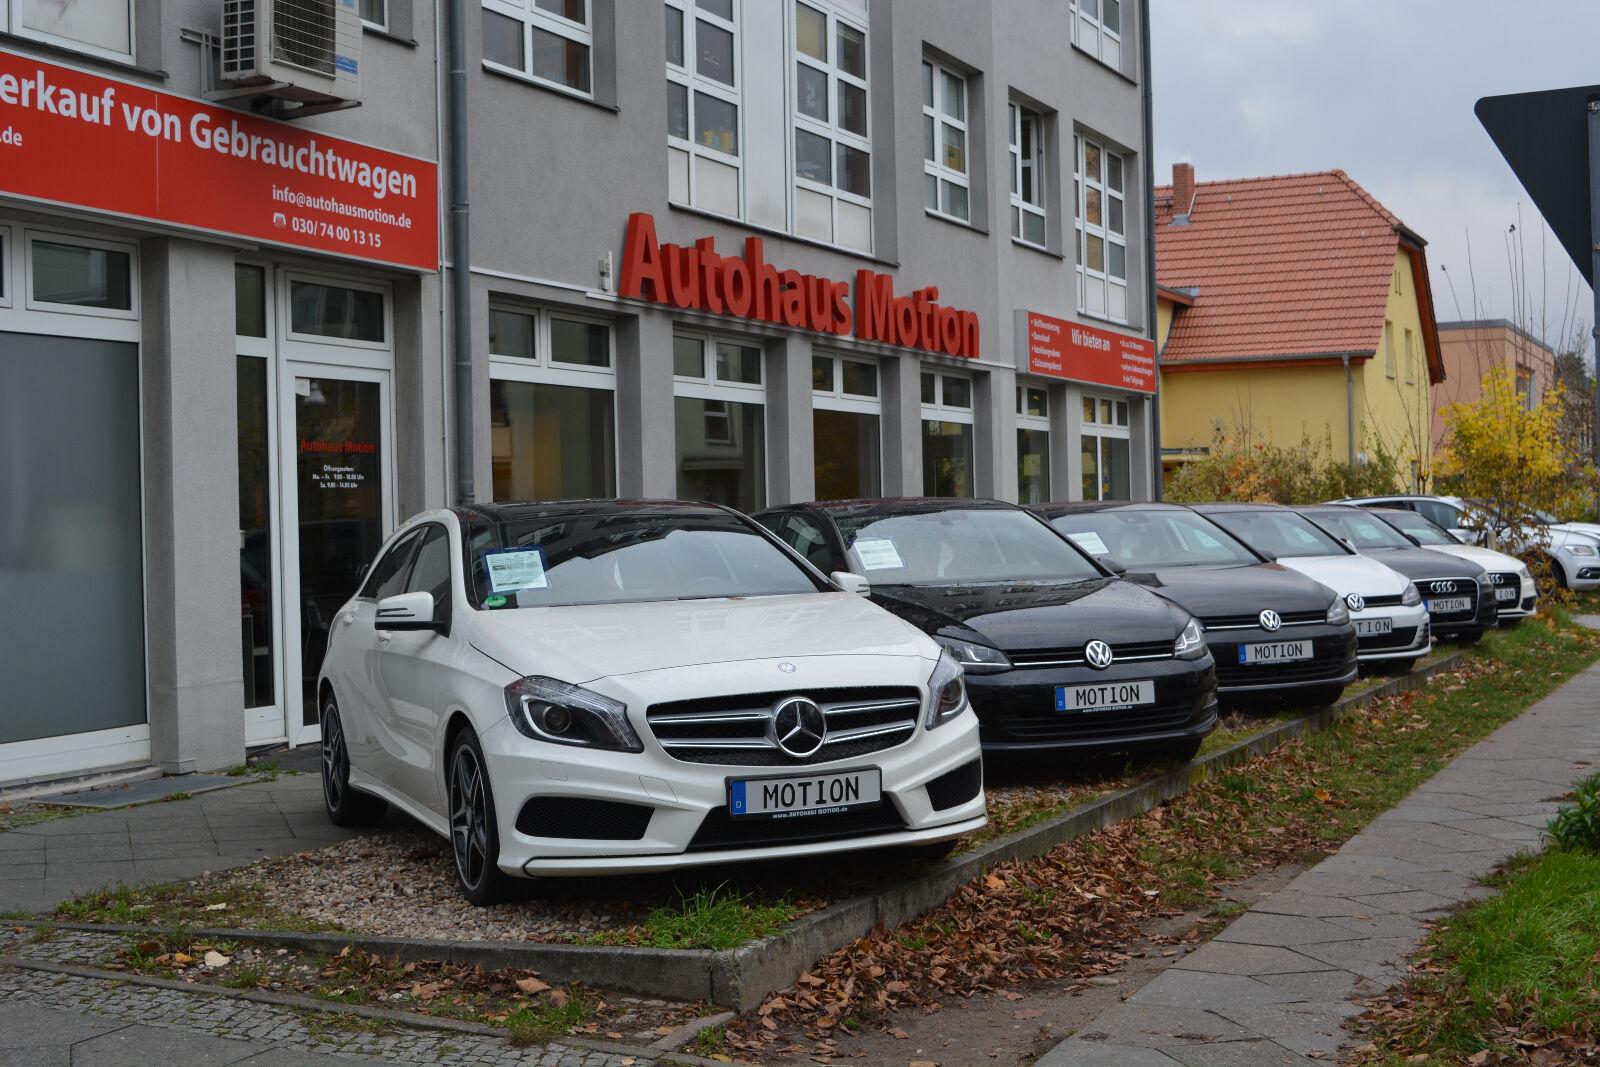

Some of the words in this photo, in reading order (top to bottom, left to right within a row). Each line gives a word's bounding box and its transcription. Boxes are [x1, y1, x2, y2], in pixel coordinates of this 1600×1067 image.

[121, 102, 182, 142] von
[189, 112, 417, 199] Gebrauchtwagen
[272, 184, 412, 229] info@autohausmotion.de
[291, 216, 318, 236] 030/
[320, 222, 335, 239] 74
[336, 226, 350, 242] 00
[353, 229, 366, 245] 13
[368, 232, 382, 248] 15
[619, 211, 853, 336] Autohaus
[856, 268, 980, 359] Motion
[1071, 328, 1083, 346] Wir
[1082, 331, 1103, 350] bieten
[1102, 340, 1111, 352] an
[301, 440, 343, 452] Autohaus
[345, 441, 375, 453] Motion
[1433, 599, 1466, 611] MOTION
[1254, 643, 1304, 660] MOTION
[1075, 684, 1140, 706] MOTION
[763, 776, 859, 809] MOTION
